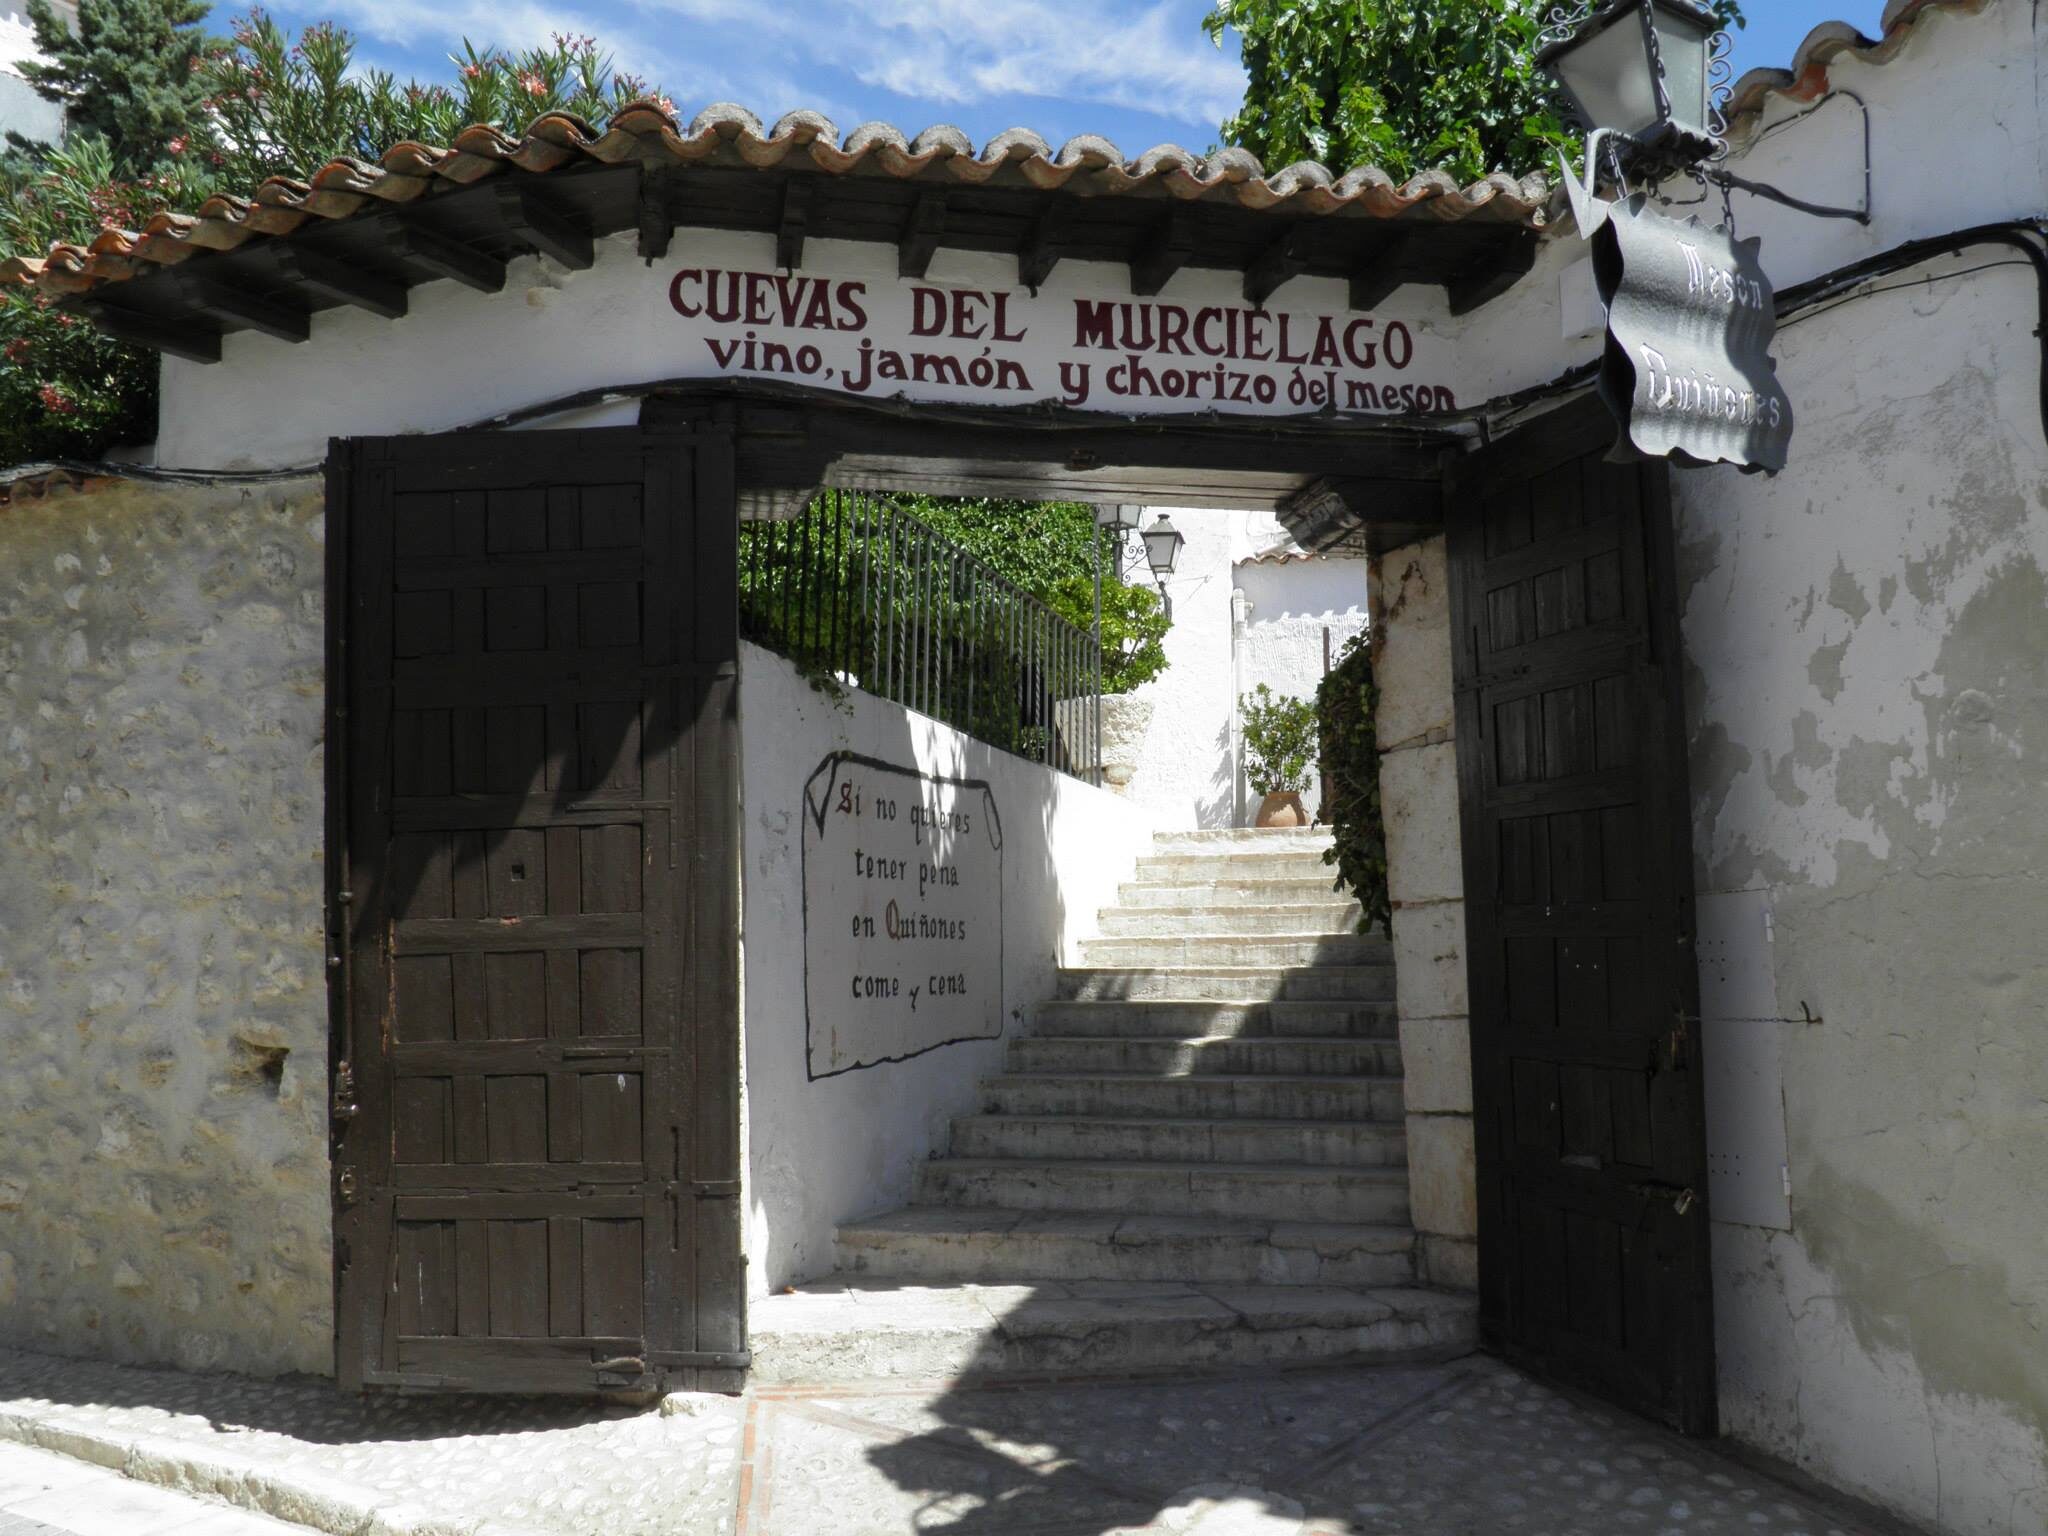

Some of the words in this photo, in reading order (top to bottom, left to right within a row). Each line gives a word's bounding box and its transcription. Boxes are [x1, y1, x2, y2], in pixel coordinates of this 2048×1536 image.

[668, 269, 869, 332] CUEVAS
[908, 287, 1029, 343] DEL
[704, 331, 834, 380] vino,
[841, 338, 1034, 392] jamón
[1058, 362, 1091, 406] y
[1106, 355, 1277, 405] chorizo
[1287, 366, 1338, 408] del
[1344, 379, 1458, 413] meson
[876, 798, 896, 820] no
[910, 802, 970, 846] quieres
[854, 848, 907, 881] tener
[919, 862, 960, 897] pena
[852, 914, 876, 939] en
[885, 899, 967, 942] Quiñones
[852, 975, 900, 998] come
[908, 985, 920, 1012] y
[928, 973, 967, 996] cena
